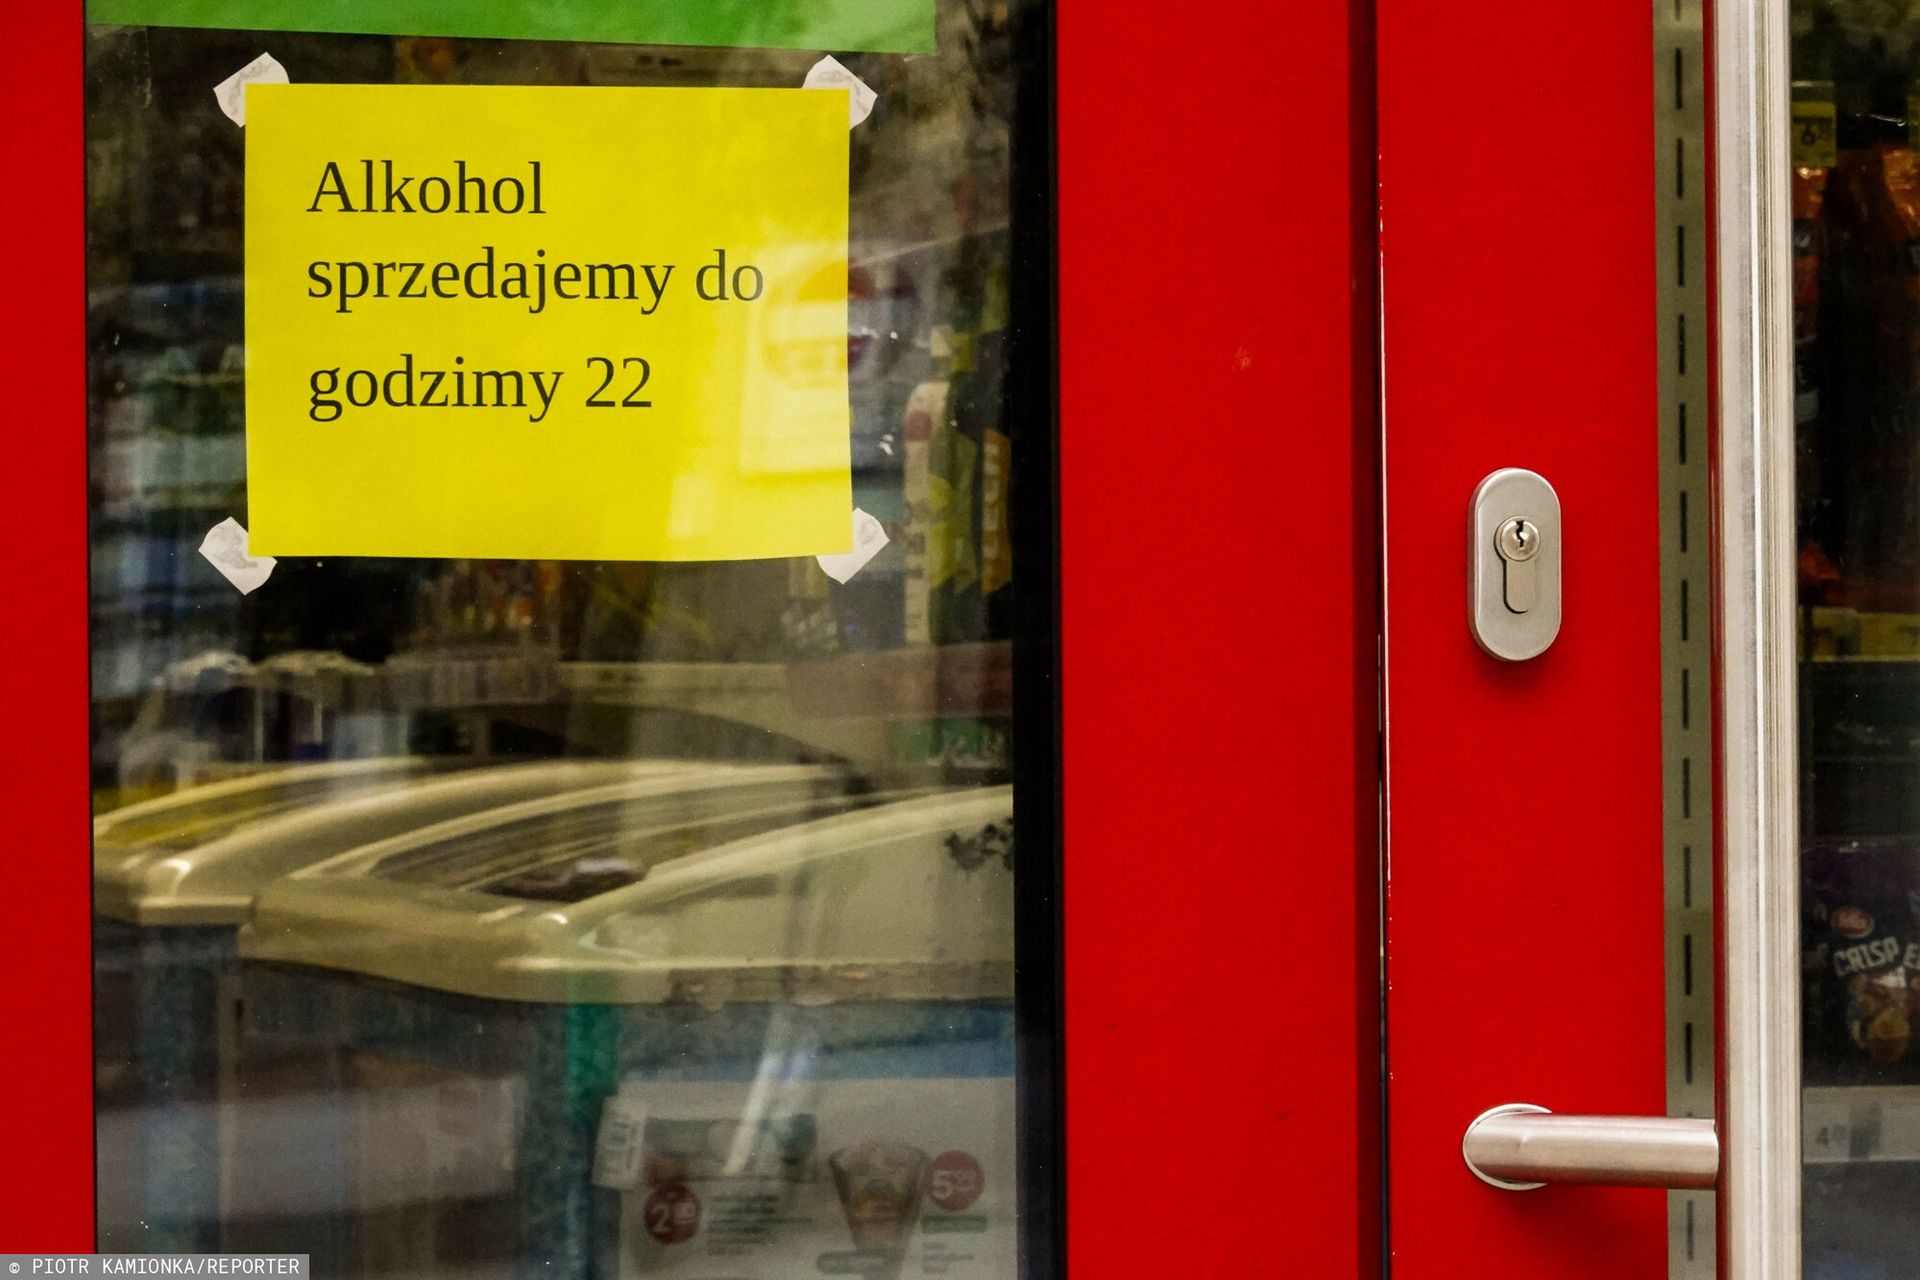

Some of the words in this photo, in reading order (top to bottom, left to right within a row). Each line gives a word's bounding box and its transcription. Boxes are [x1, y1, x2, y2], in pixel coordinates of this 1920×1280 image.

[306, 159, 547, 215] Alkohol
[307, 246, 676, 315] sprzedajemy
[695, 248, 763, 302] do
[309, 353, 564, 423] godzimy
[585, 356, 653, 408] 22
[1833, 936, 1899, 977] CRISP
